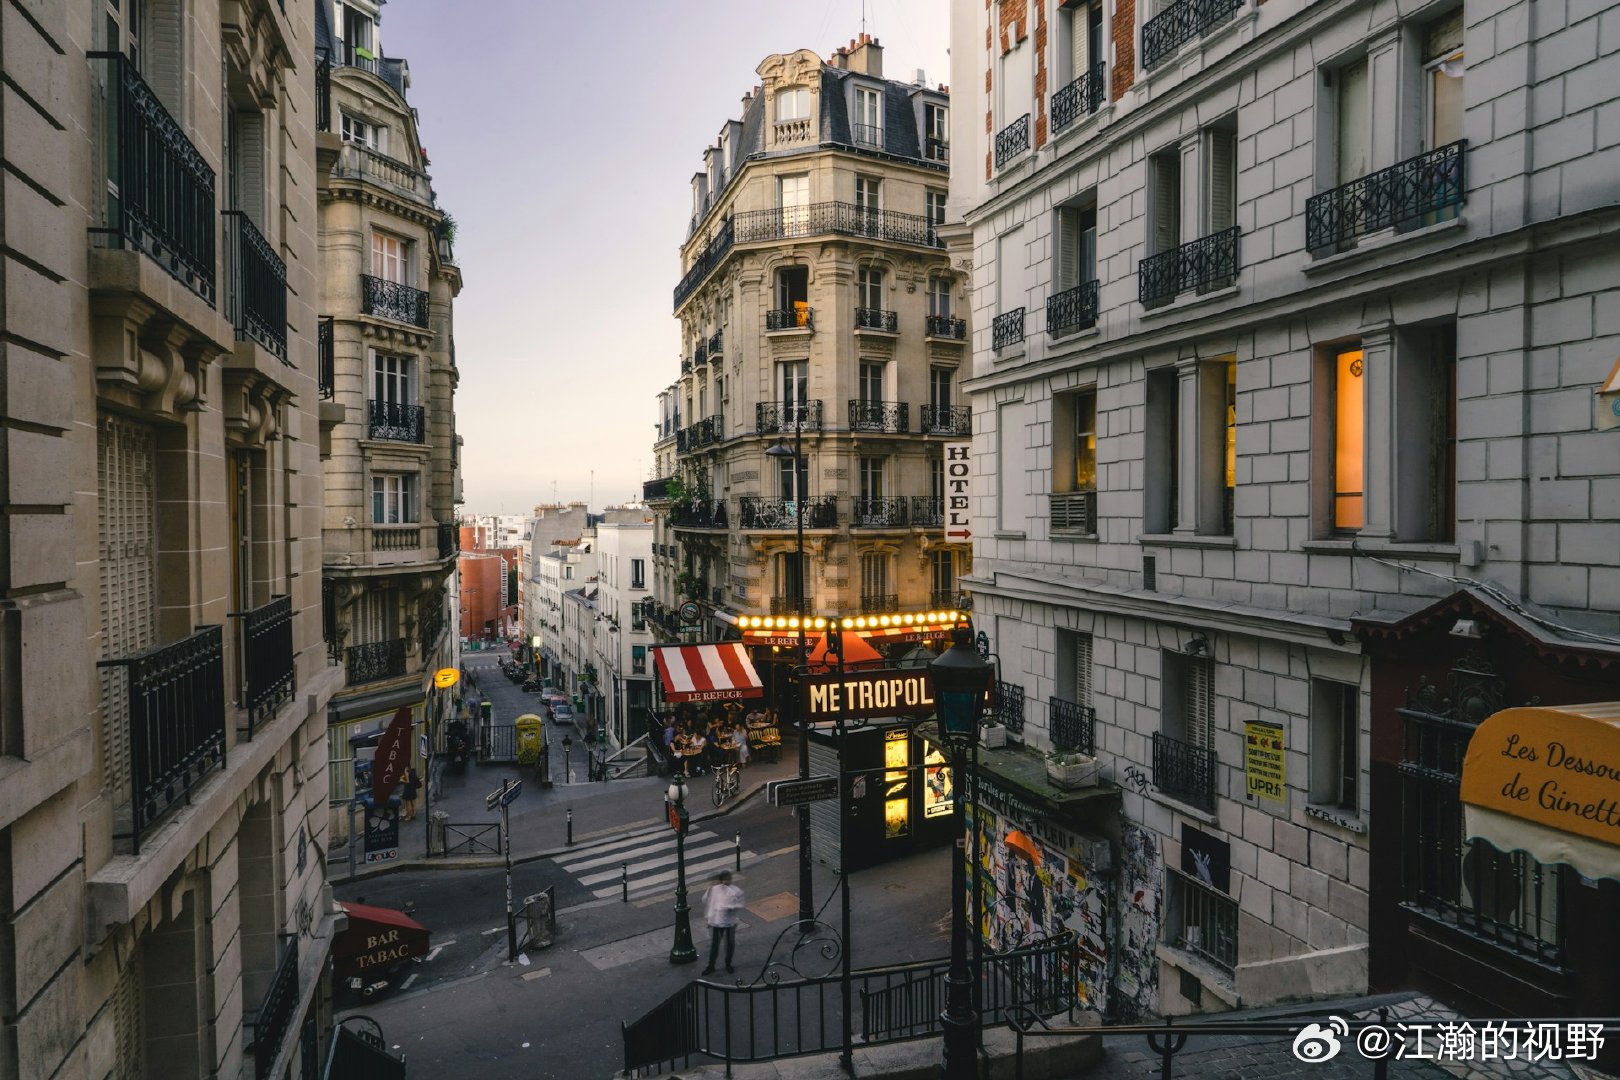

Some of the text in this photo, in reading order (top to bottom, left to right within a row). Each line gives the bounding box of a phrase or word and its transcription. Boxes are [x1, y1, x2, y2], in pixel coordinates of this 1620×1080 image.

[947, 446, 970, 526] HOTEL
[764, 637, 776, 645] LE
[688, 690, 743, 702] LE REFUGE
[809, 677, 988, 714] METROPOL
[383, 727, 406, 784] TABAC
[1501, 734, 1539, 762] Les
[1501, 771, 1620, 827] de Ginett
[367, 929, 399, 949] BAR
[356, 944, 409, 968] TABAC
